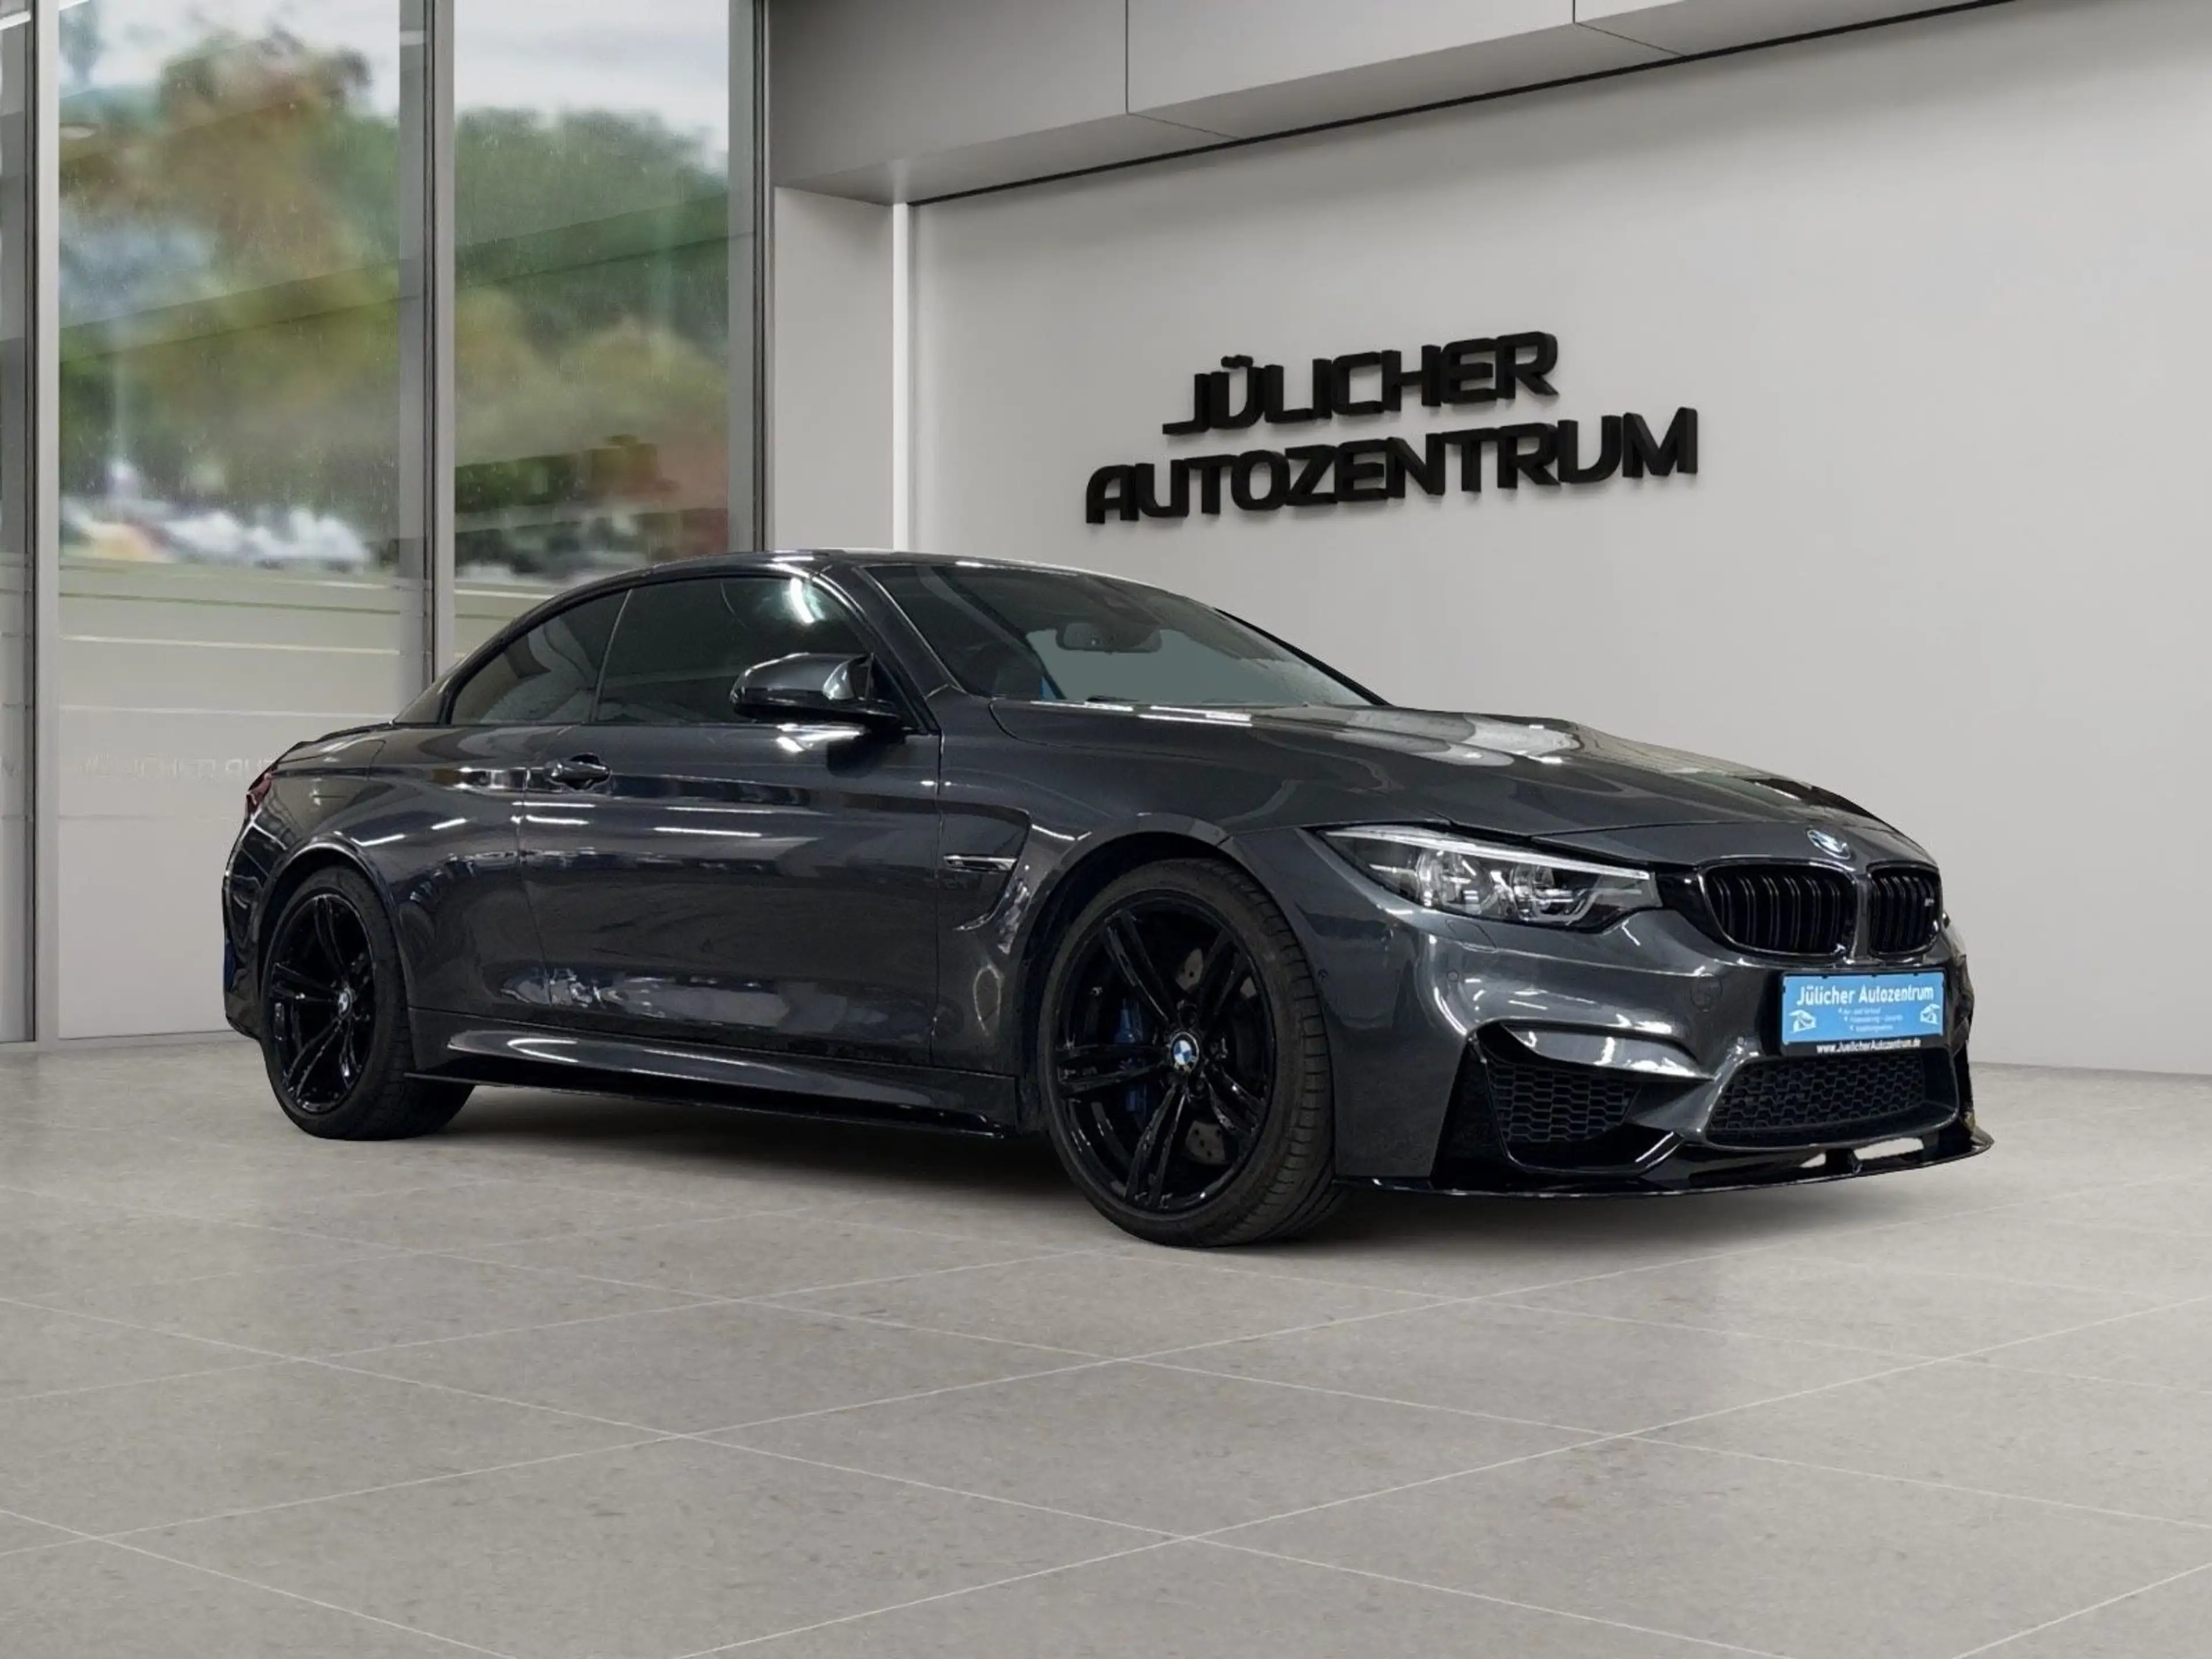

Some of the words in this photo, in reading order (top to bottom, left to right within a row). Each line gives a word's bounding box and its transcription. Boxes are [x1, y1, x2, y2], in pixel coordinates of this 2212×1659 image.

[1162, 331, 1559, 434] JÜLICHER
[1086, 407, 1698, 524] AUTOZENTRUM
[1797, 984, 1854, 1006] Jülicher
[1858, 984, 1934, 1003] Autozentrum
